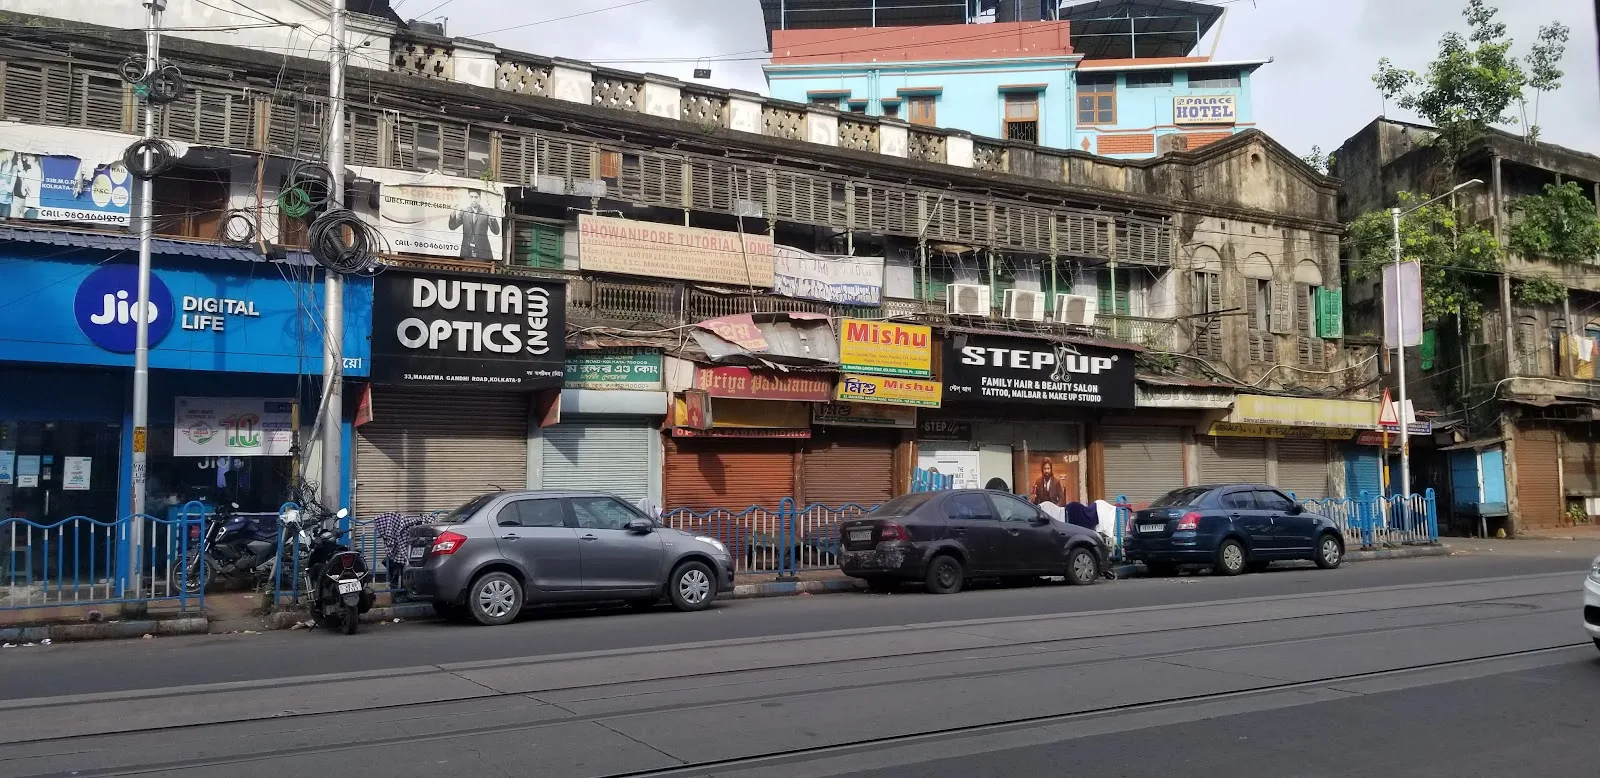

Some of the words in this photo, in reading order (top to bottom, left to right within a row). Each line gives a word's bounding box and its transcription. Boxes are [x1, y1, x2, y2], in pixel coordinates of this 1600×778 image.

[1186, 97, 1232, 105] PALACE
[1177, 106, 1233, 118] HOTEL
[582, 222, 674, 244] BHOWANIPORE
[678, 233, 737, 251] TUTORIAL
[412, 277, 523, 315] DUTTA
[90, 290, 158, 325] Jio
[182, 296, 260, 316] DIGITAL
[182, 314, 224, 331] LIFE
[397, 318, 522, 354] OPTICS
[846, 322, 927, 349] Mishu
[961, 346, 1054, 370] STEP
[1066, 354, 1112, 375] UP
[700, 369, 746, 394] Priya
[844, 378, 877, 395] মিশু
[884, 380, 935, 393] Mishu
[981, 376, 1012, 387] FAMILY
[1014, 379, 1033, 389] HAIR
[1034, 381, 1040, 389] &
[1041, 382, 1072, 391] BEAUTY
[1073, 383, 1098, 394] SALON
[982, 387, 1012, 398] TATTOO,
[1012, 390, 1042, 399] NAILBAR
[1042, 391, 1048, 399] &
[1048, 392, 1068, 401] MAKE
[1068, 393, 1078, 401] UP
[1078, 394, 1102, 403] STUDIO
[924, 420, 947, 432] STEP
